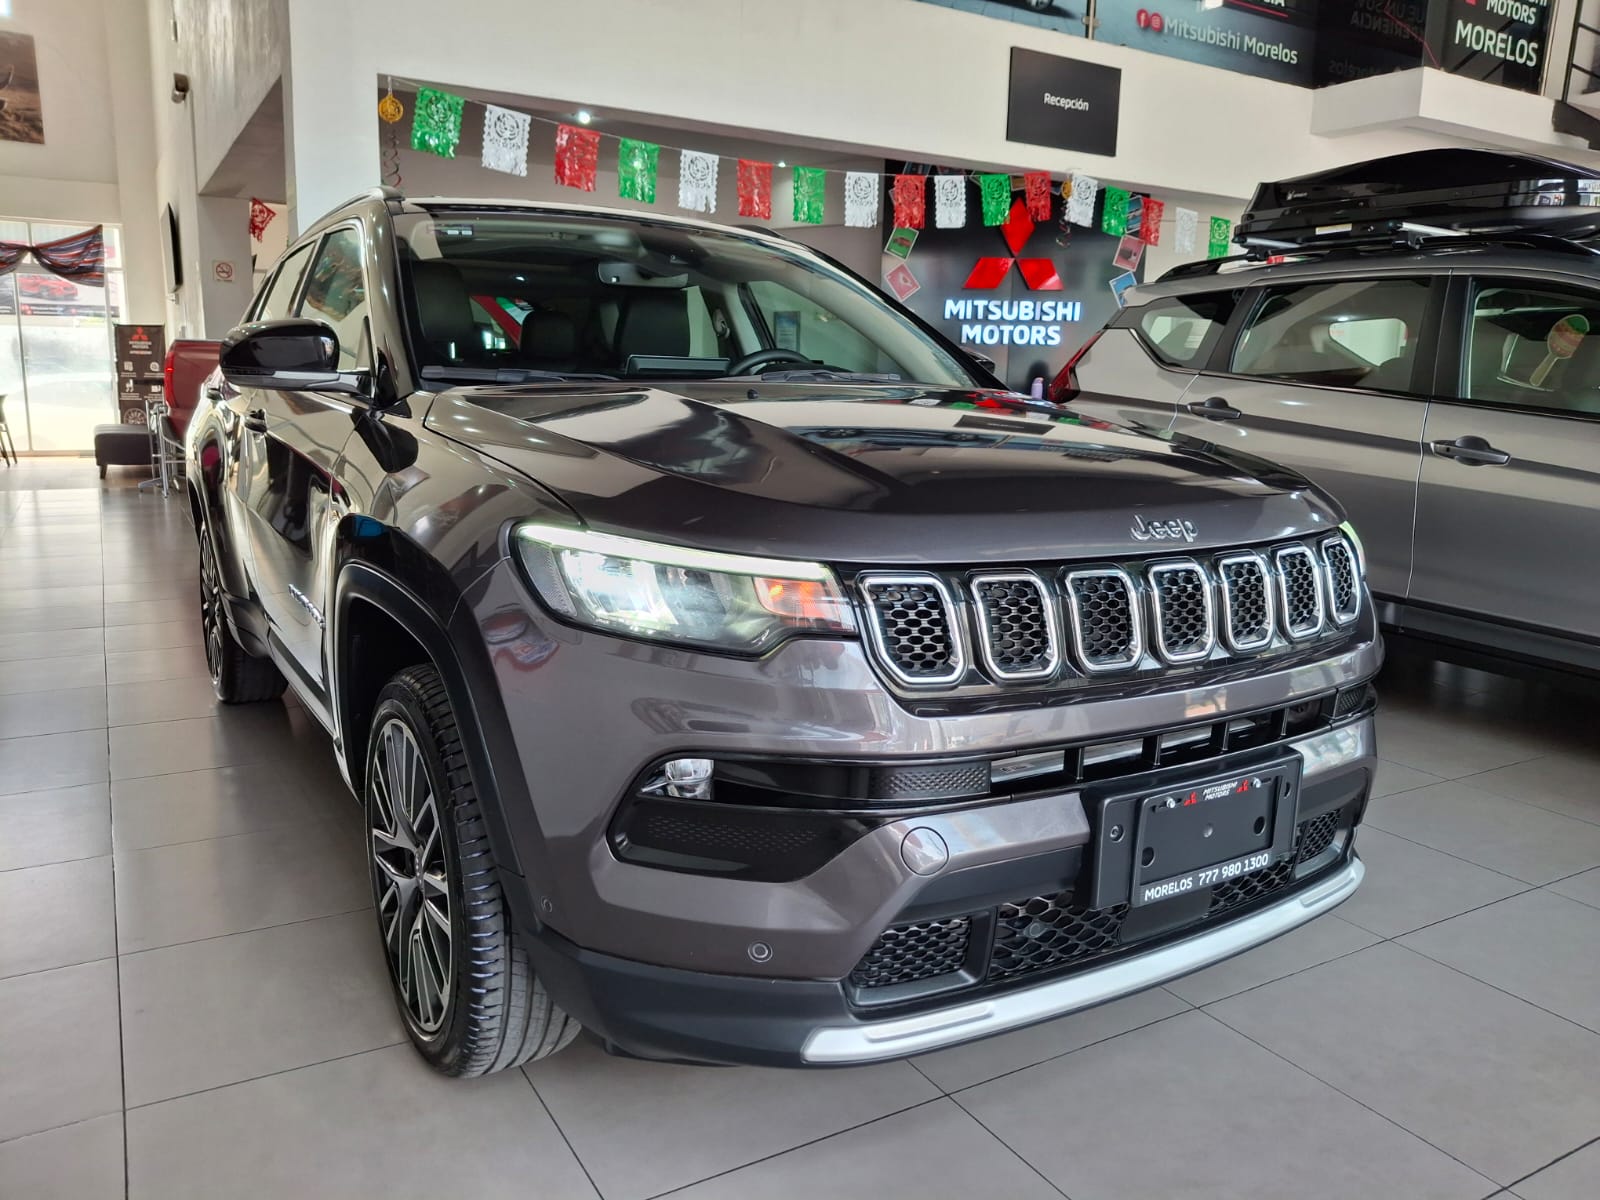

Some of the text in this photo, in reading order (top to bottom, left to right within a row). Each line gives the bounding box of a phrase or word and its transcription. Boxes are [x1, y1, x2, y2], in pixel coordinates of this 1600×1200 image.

[1486, 0, 1537, 25] MOTORS
[1164, 16, 1298, 65] Mitsubishi Morelos
[1455, 19, 1539, 67] MORELOS
[1043, 92, 1089, 111] Recepción
[944, 298, 1082, 321] MITSUBISHI
[961, 323, 1061, 346] MOTORS
[1131, 514, 1198, 542] Jeep
[1204, 789, 1230, 801] MOTORS
[1144, 853, 1269, 901] MORELOS 777 980 1300
